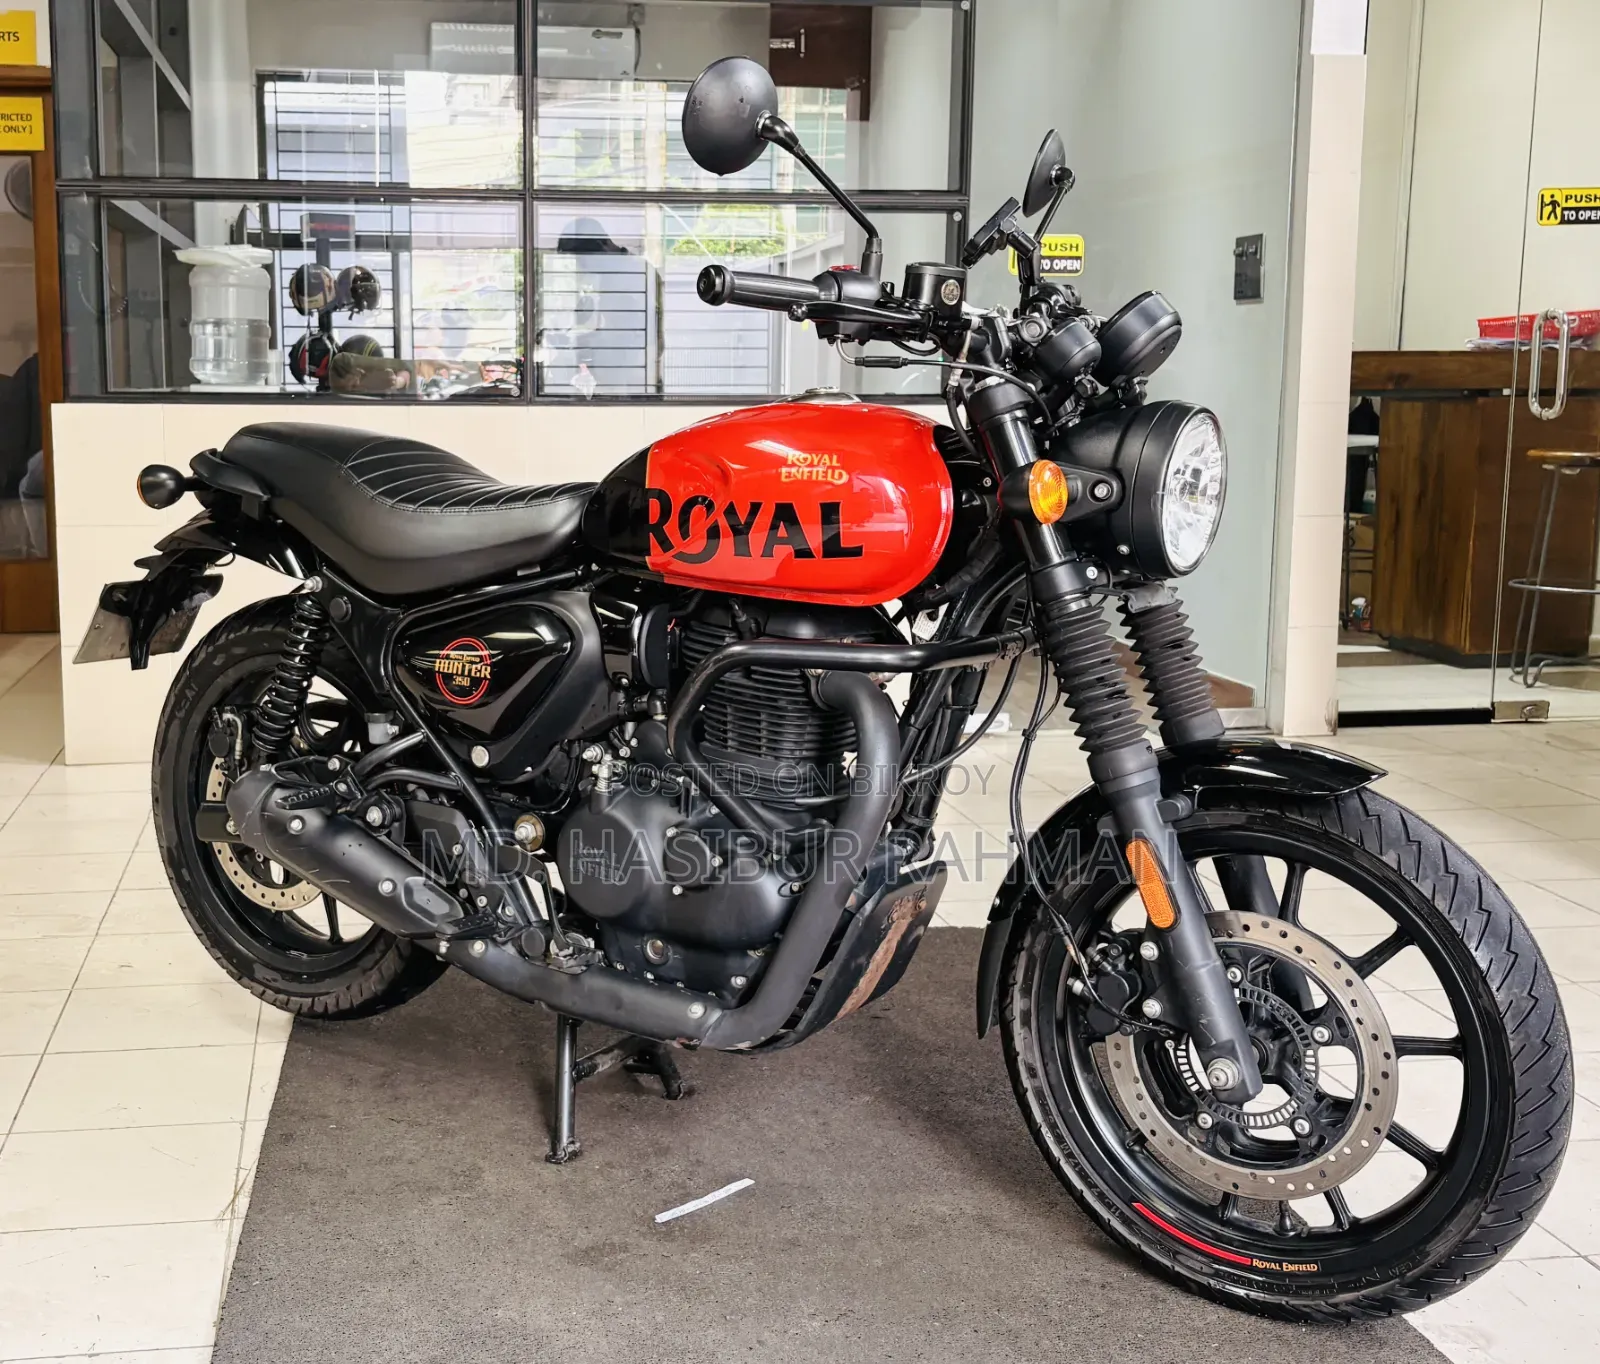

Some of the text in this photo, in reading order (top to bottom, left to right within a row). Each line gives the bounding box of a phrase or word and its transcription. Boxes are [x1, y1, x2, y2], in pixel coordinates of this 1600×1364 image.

[3, 125, 27, 133] ONLY
[1563, 210, 1600, 220] TO OPE
[1052, 259, 1080, 270] OPEN
[786, 452, 841, 468] ROYAL
[780, 467, 849, 485] ENFIELD
[645, 487, 864, 565] ROYAL
[435, 659, 491, 678] HUNTER
[453, 675, 470, 686] 350
[1252, 1258, 1318, 1272] ROYAL ENFIELD
